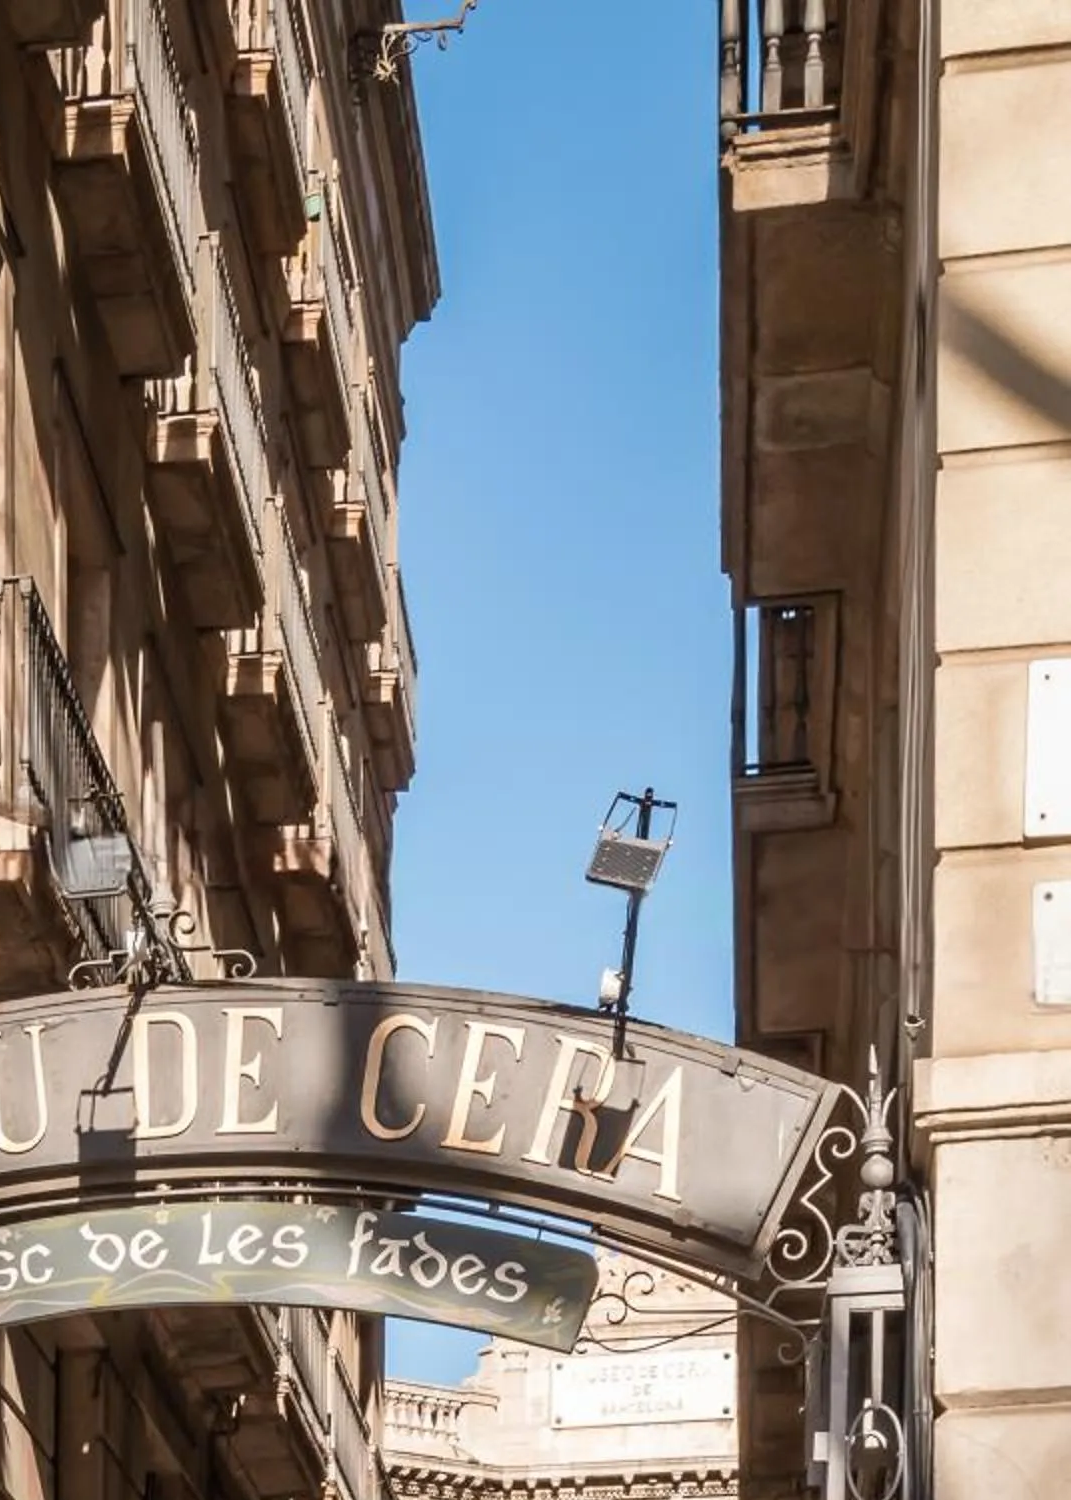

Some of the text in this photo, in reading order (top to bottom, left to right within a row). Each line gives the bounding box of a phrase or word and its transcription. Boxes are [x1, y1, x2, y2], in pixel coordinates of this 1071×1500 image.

[126, 1004, 284, 1141] DE
[359, 1011, 683, 1203] CERA
[79, 1221, 168, 1274] de
[346, 1211, 530, 1305] fades
[571, 1364, 634, 1385] USEO
